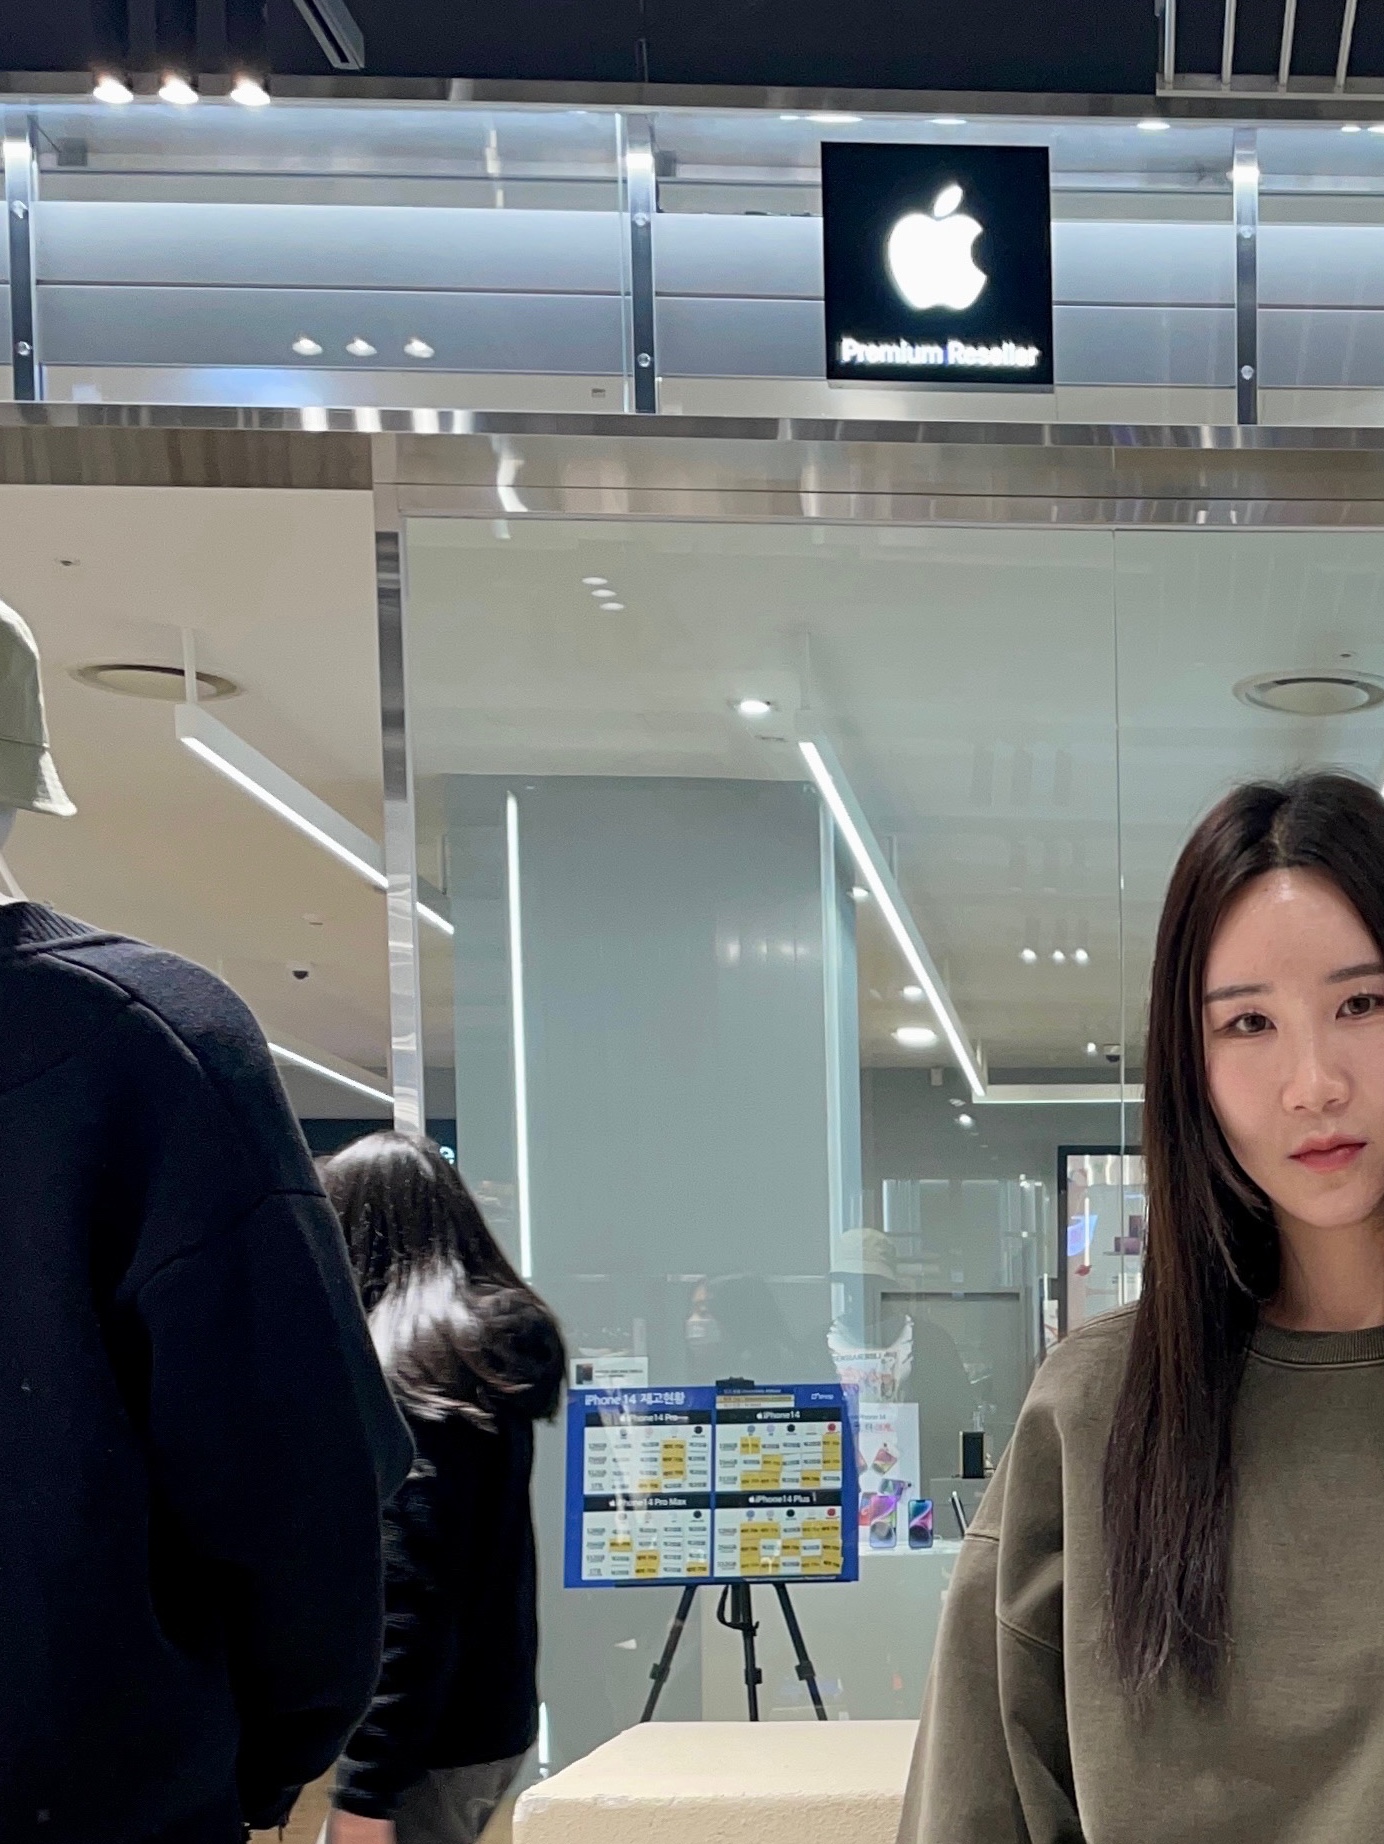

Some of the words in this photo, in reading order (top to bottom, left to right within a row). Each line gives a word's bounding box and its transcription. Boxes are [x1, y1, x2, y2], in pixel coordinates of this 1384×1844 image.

[840, 336, 943, 364] Premium
[946, 338, 1041, 367] Reseller
[584, 1393, 621, 1406] iPhone
[624, 1394, 637, 1405] 14
[640, 1391, 686, 1406] 재고현황
